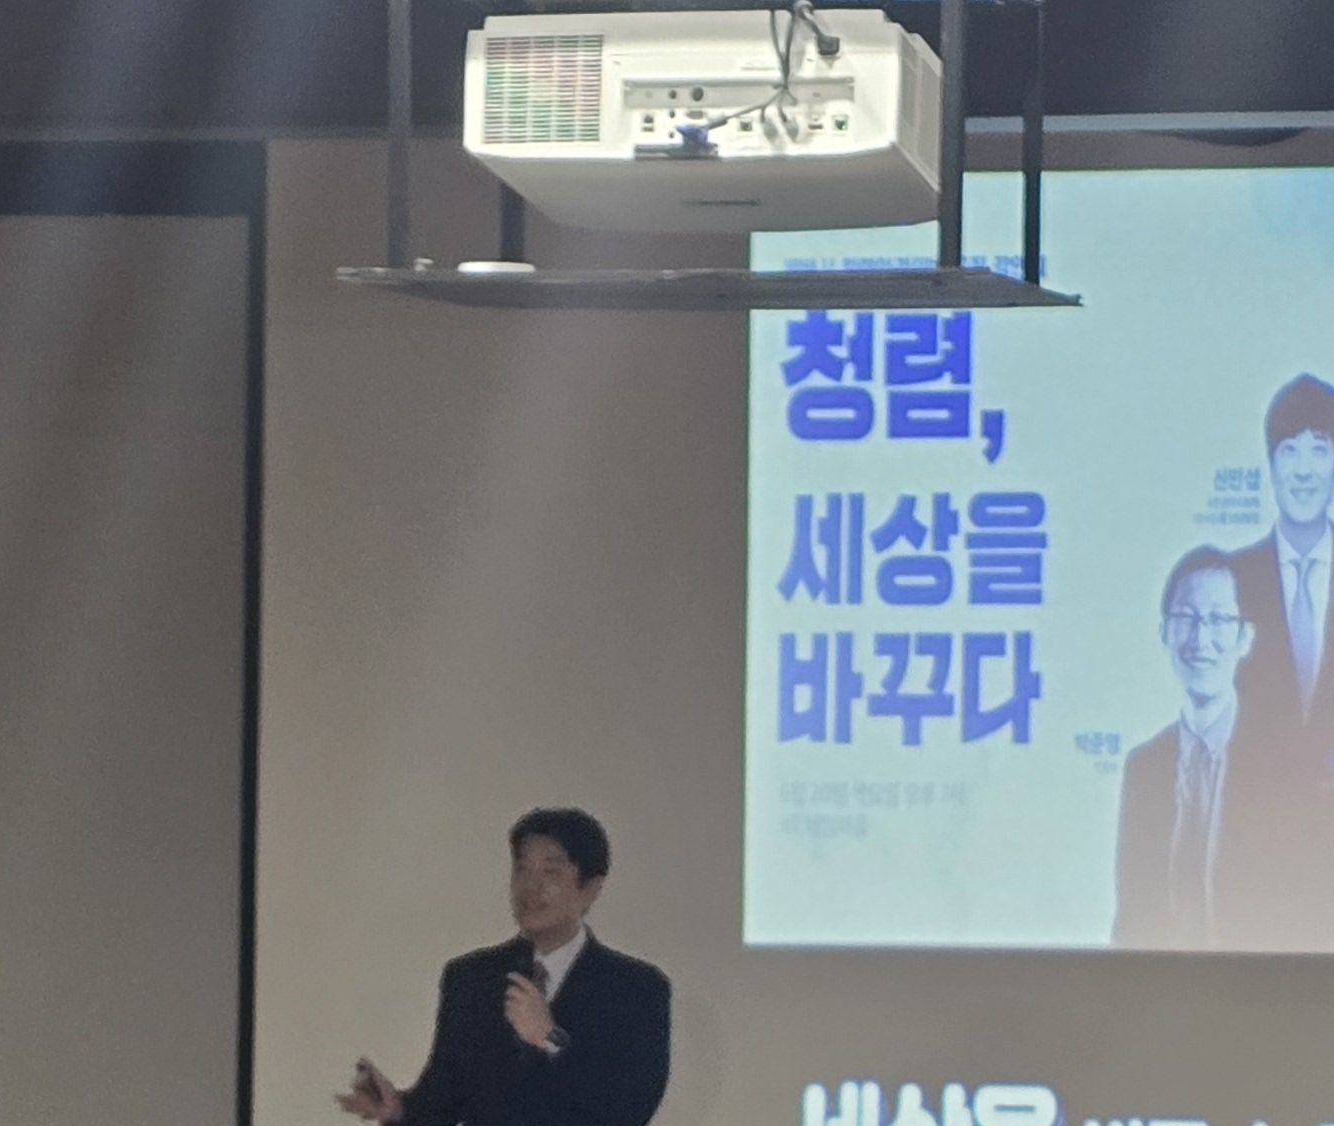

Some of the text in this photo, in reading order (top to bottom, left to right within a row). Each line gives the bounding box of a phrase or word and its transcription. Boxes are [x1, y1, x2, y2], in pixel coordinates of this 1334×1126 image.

[780, 310, 1008, 462] 청렴,
[778, 491, 1051, 608] 세상을
[778, 630, 1043, 747] 바꾸다
